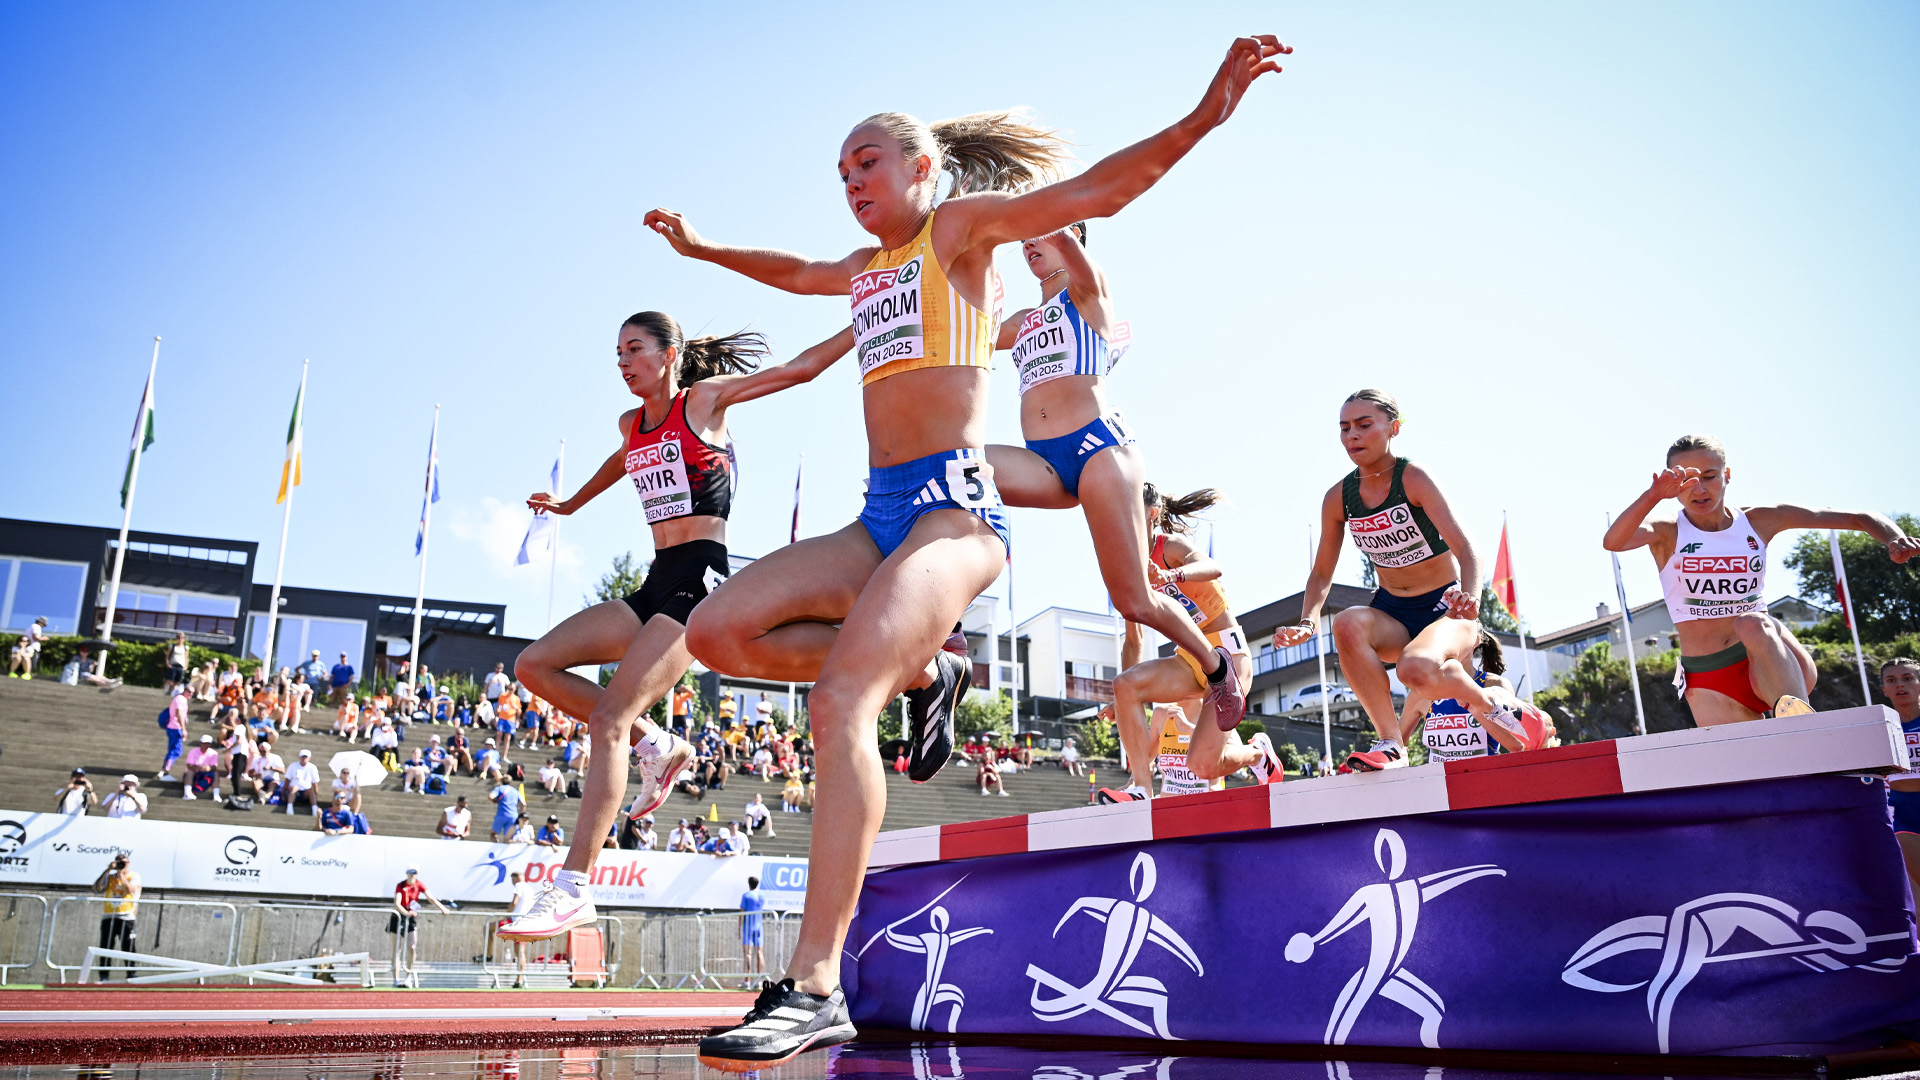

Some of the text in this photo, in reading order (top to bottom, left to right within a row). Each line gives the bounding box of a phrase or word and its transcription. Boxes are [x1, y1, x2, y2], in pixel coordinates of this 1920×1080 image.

[883, 341, 913, 361] 2025
[1039, 363, 1064, 377] 2025
[625, 449, 660, 472] SPAR
[634, 469, 677, 494] BAYIR
[963, 465, 985, 502] 5
[664, 503, 685, 517] 2025
[1349, 515, 1390, 531] SPAR
[1353, 525, 1420, 549] O'CONNOR
[1401, 549, 1425, 565] 2025
[1684, 558, 1746, 572] SPAR
[1685, 577, 1759, 594] VARGA
[1690, 606, 1734, 617] BERGEN
[1425, 716, 1466, 730] SPAR
[1427, 732, 1481, 747] BLAGA
[76, 843, 134, 857] ScorePlay
[300, 856, 349, 870] ScorePlay
[215, 867, 261, 877] SPORTZ
[213, 876, 260, 884] INTERACTIVE
[594, 890, 645, 900] help to win
